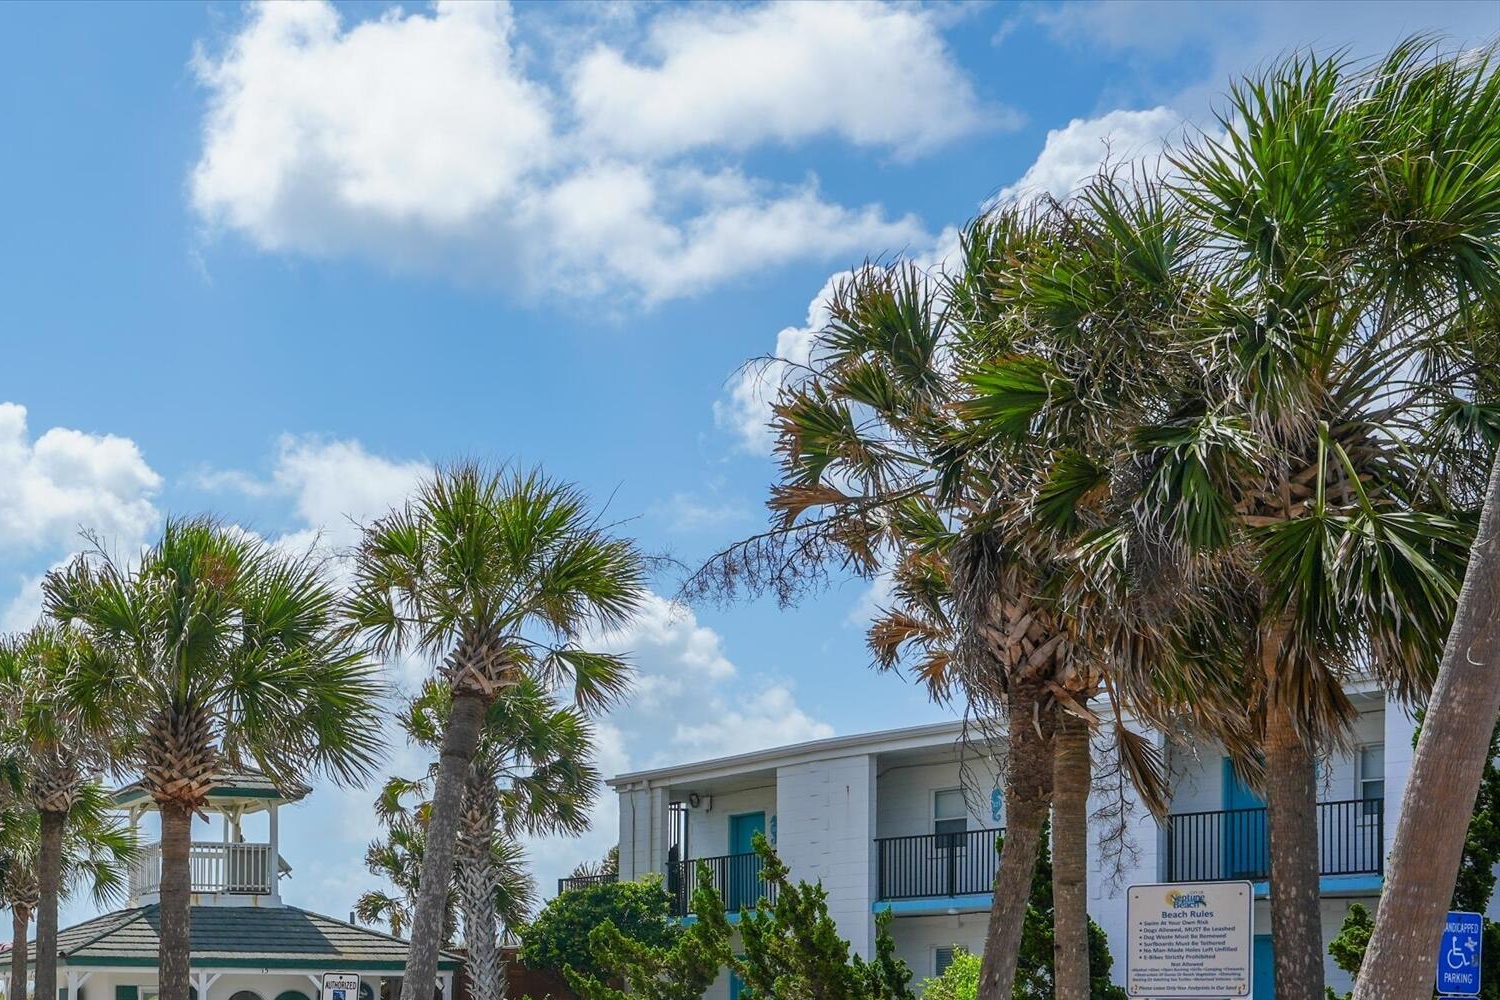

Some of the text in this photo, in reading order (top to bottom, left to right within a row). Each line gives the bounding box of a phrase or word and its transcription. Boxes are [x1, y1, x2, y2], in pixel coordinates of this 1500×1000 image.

[1171, 894, 1205, 902] Neptune
[1161, 910, 1188, 918] Beach
[1444, 922, 1478, 934] ANDICAPPED
[1444, 972, 1473, 984] PARKING
[325, 981, 357, 990] AUTHORIZED
